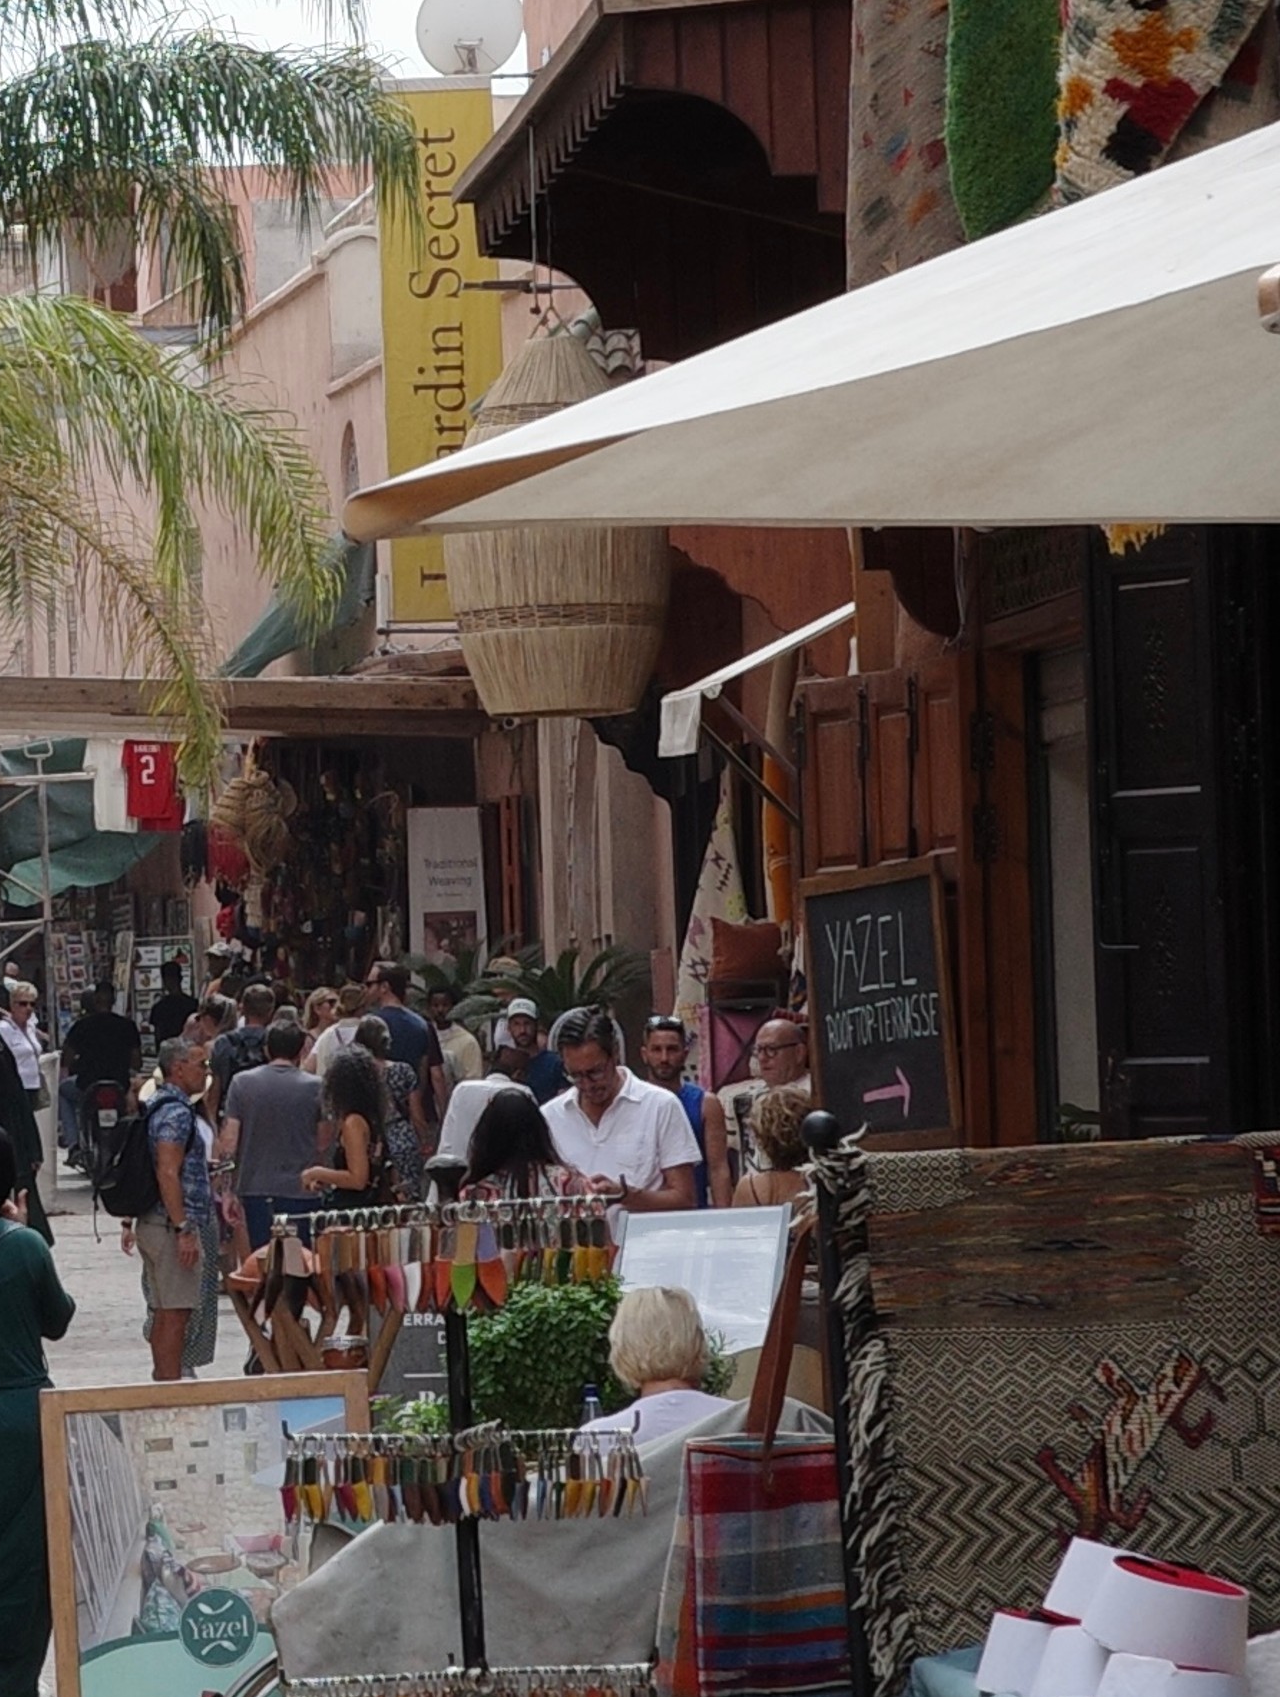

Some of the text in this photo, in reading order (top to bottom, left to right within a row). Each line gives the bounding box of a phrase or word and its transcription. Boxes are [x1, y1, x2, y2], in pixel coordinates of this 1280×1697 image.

[408, 127, 466, 458] ardin Secret
[139, 754, 155, 785] 2
[825, 911, 917, 1008] YAZEL
[186, 1614, 249, 1641] Yazel
